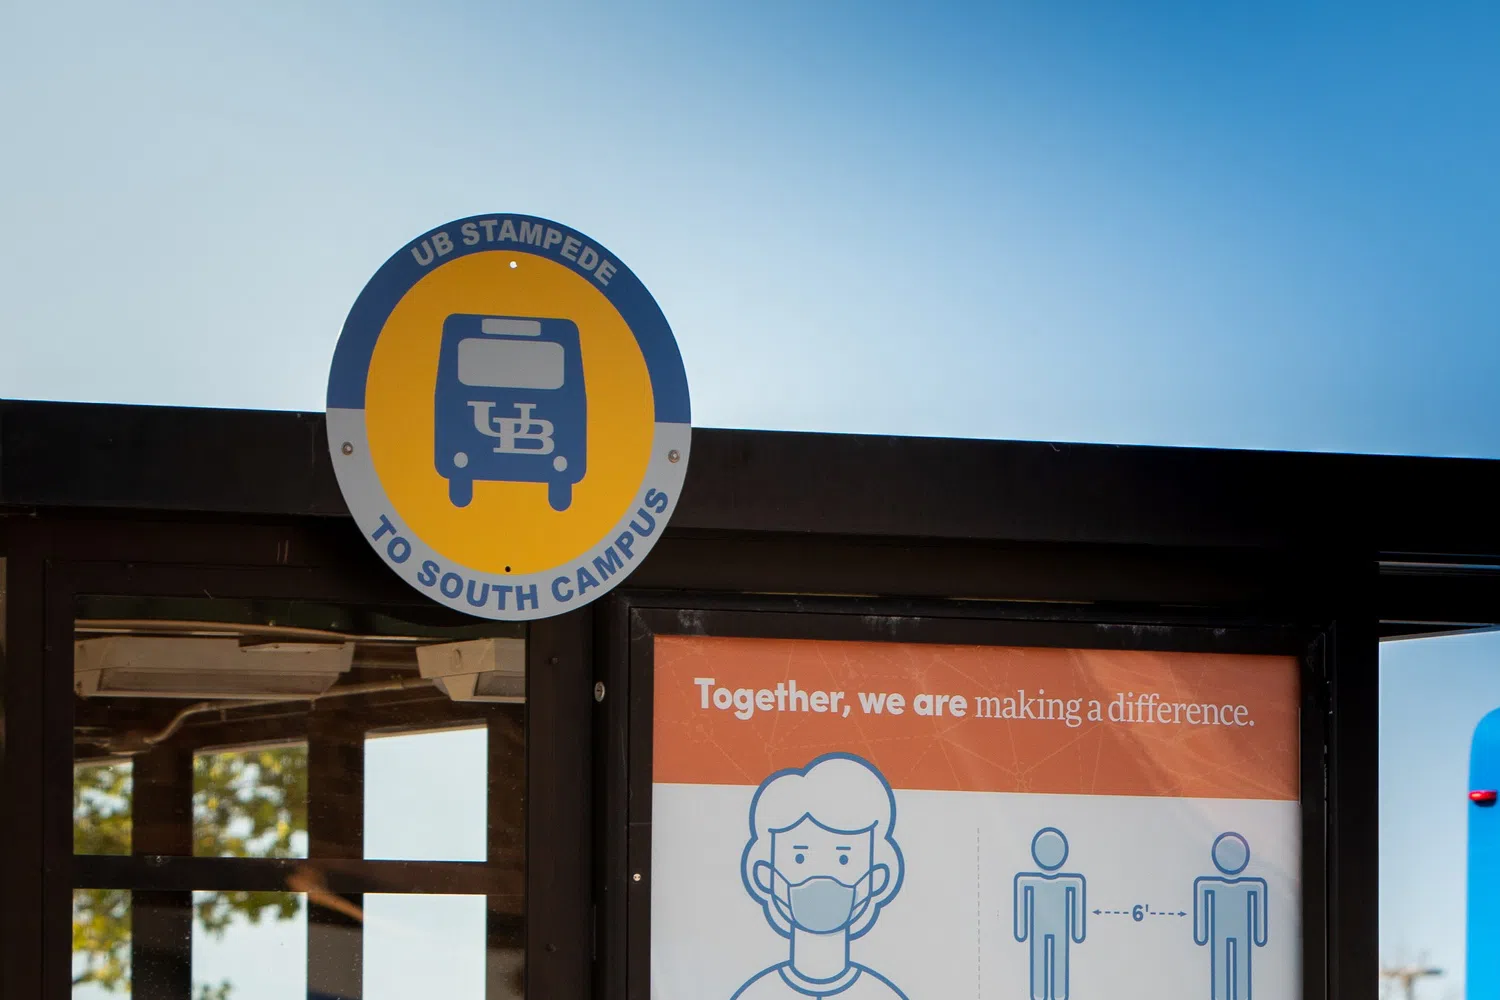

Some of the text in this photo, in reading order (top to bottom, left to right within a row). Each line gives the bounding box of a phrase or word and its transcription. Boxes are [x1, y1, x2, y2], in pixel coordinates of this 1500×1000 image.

[410, 218, 618, 286] UB STAMPEDE
[467, 400, 556, 456] UB
[371, 487, 669, 611] TO SOUTH CAMPUS
[694, 678, 1254, 728] Together, we are making a difference.
